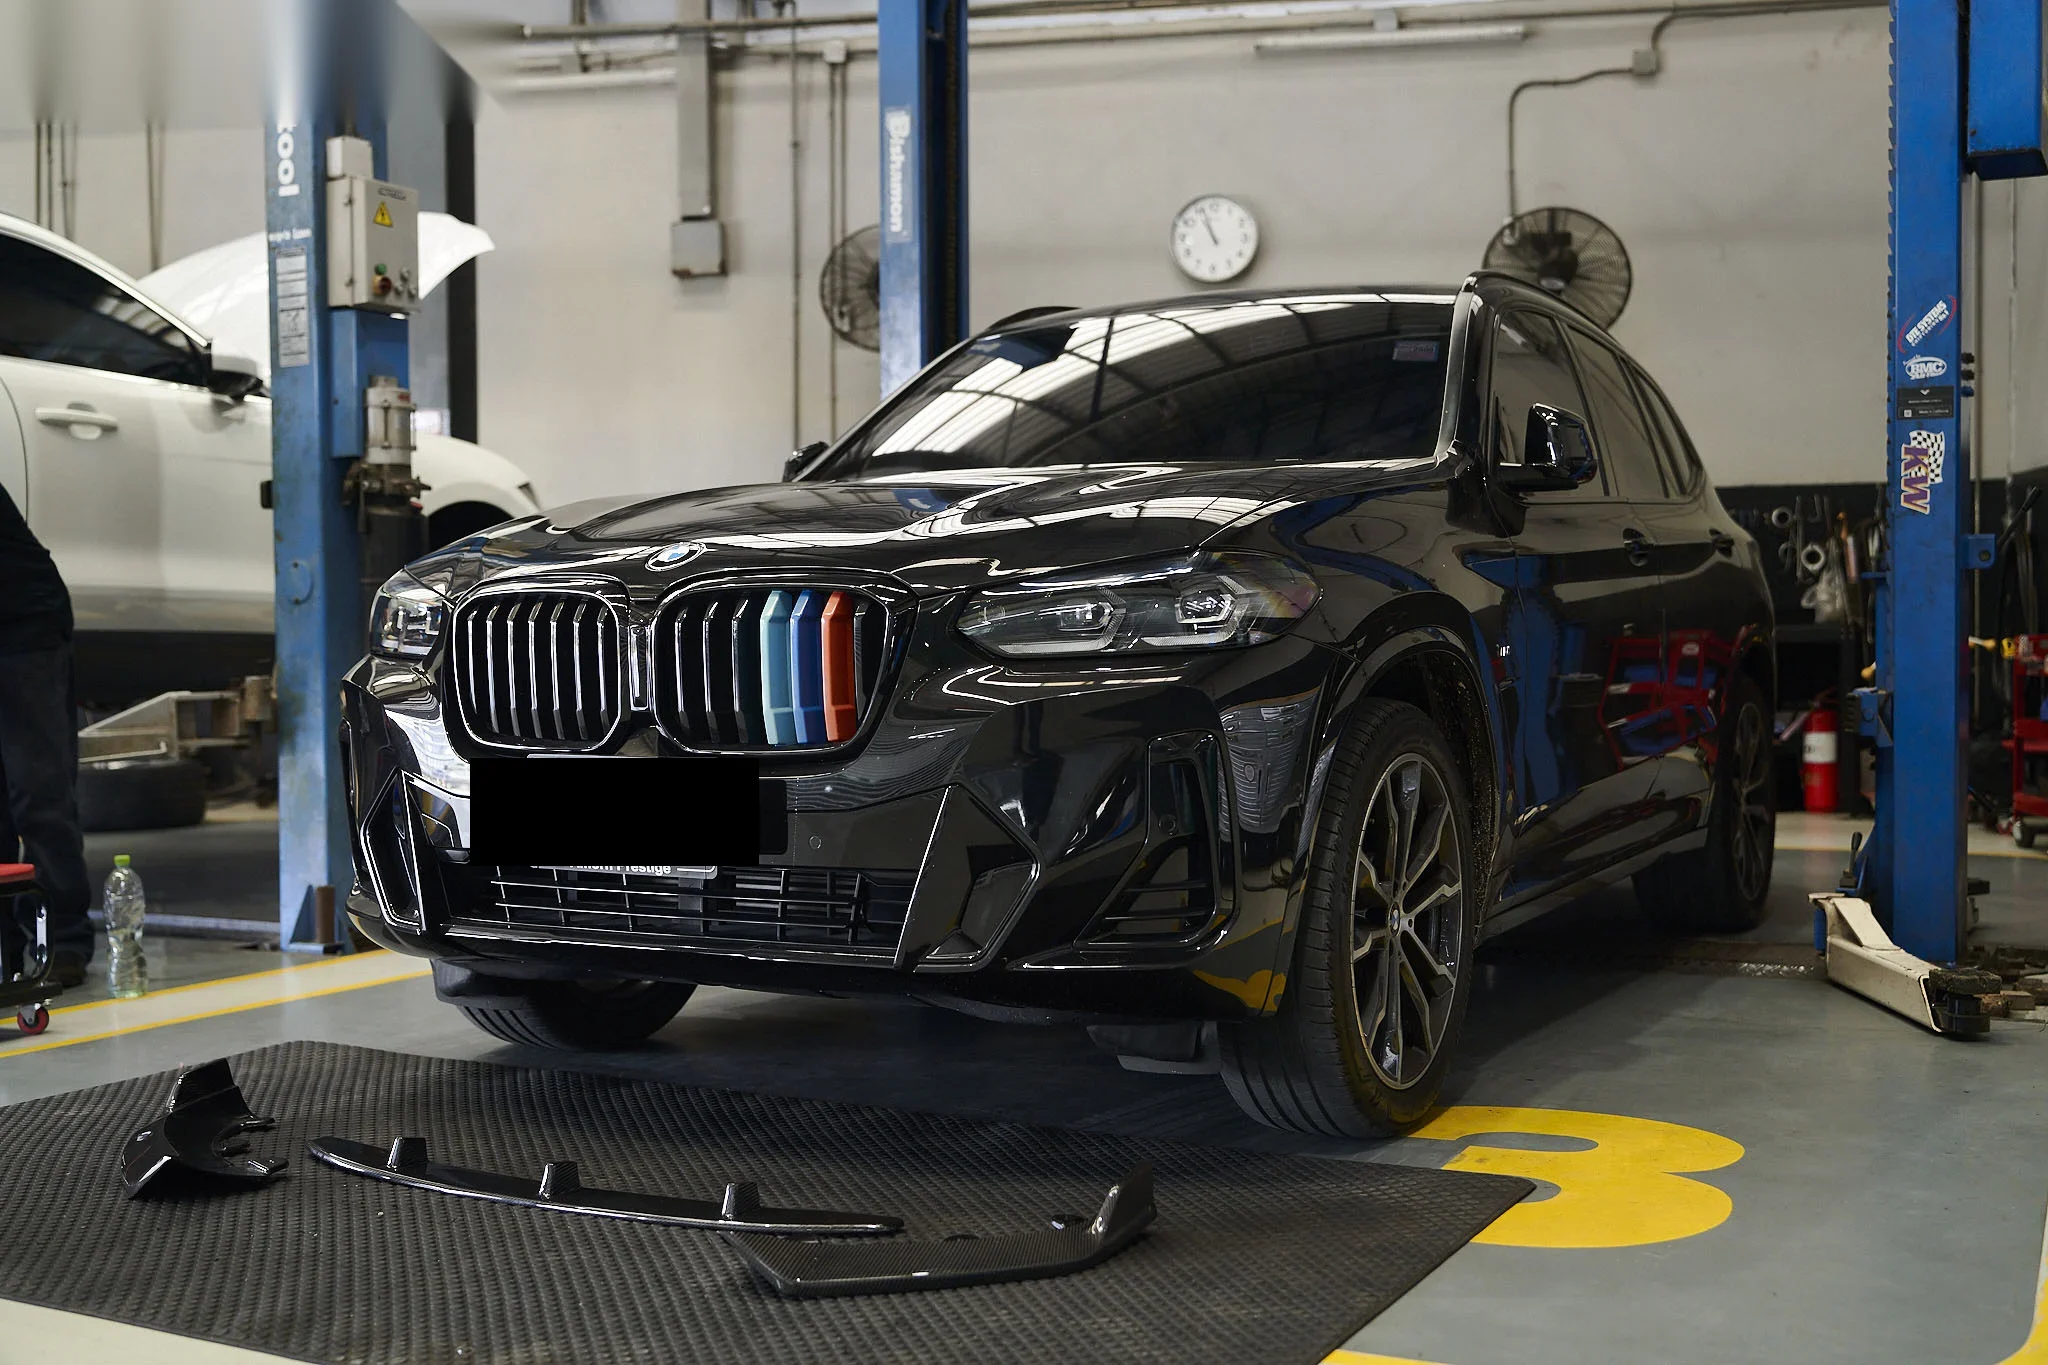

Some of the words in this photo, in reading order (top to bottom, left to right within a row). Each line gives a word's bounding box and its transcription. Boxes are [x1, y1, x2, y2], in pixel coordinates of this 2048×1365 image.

[277, 124, 300, 197] ool
[1917, 300, 1947, 331] SYSTEMS
[1910, 362, 1943, 374] BMC
[1901, 444, 1930, 514] KW
[1408, 1105, 1745, 1248] 3
